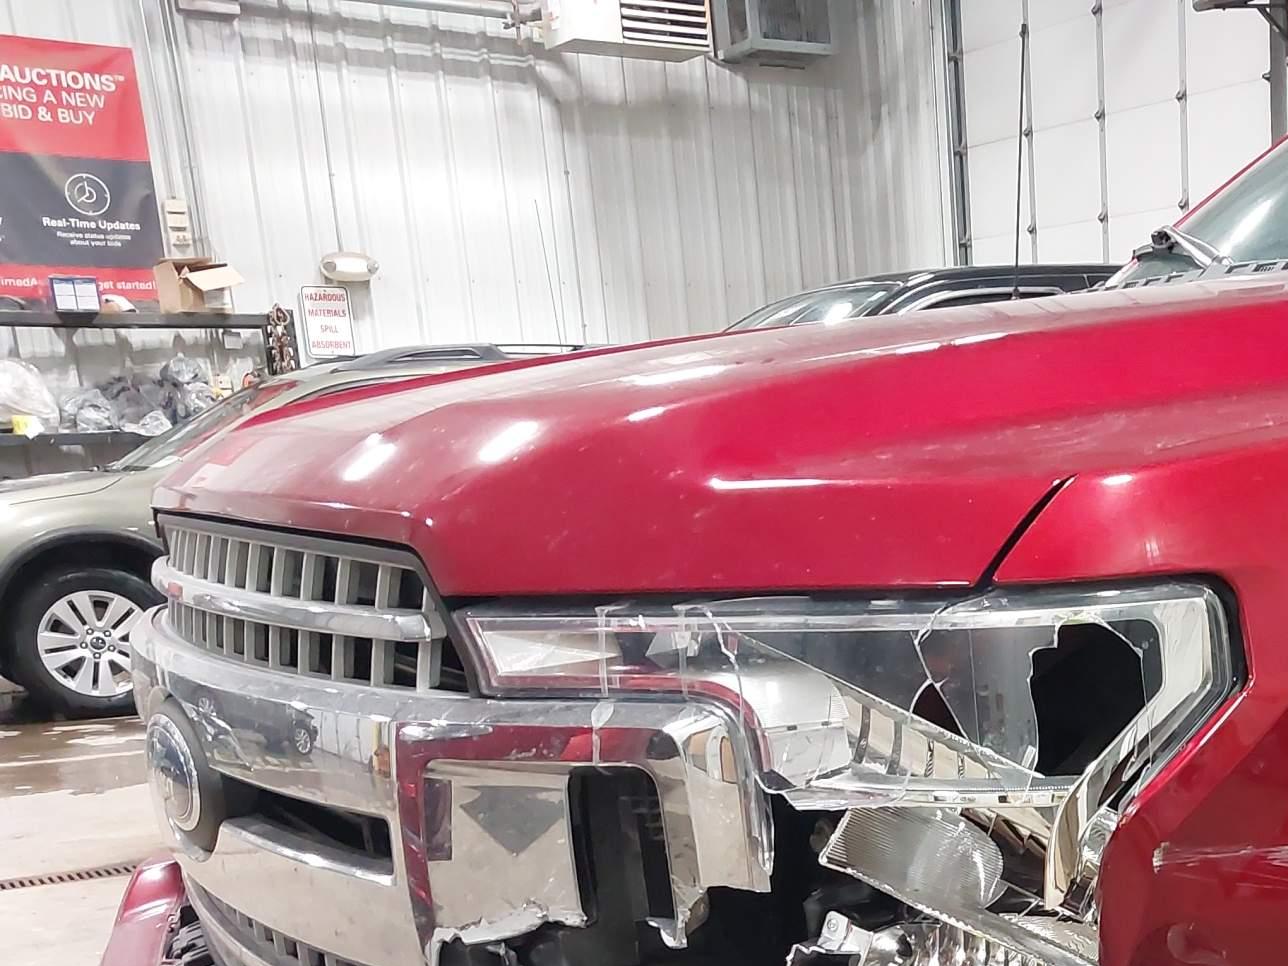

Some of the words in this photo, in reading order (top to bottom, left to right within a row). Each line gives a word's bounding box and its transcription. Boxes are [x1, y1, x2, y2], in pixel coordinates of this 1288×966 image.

[43, 90, 57, 105] A
[62, 91, 105, 109] NEW
[1, 103, 33, 120] BID
[38, 106, 54, 122] &
[57, 108, 95, 126] BUY
[42, 217, 97, 229] Real-Time
[98, 219, 141, 231] Updates
[304, 293, 346, 302] HAZARDOUS
[308, 308, 347, 318] MATERIALS
[320, 324, 339, 334] SPILL
[311, 340, 352, 350] ABSORBENT
